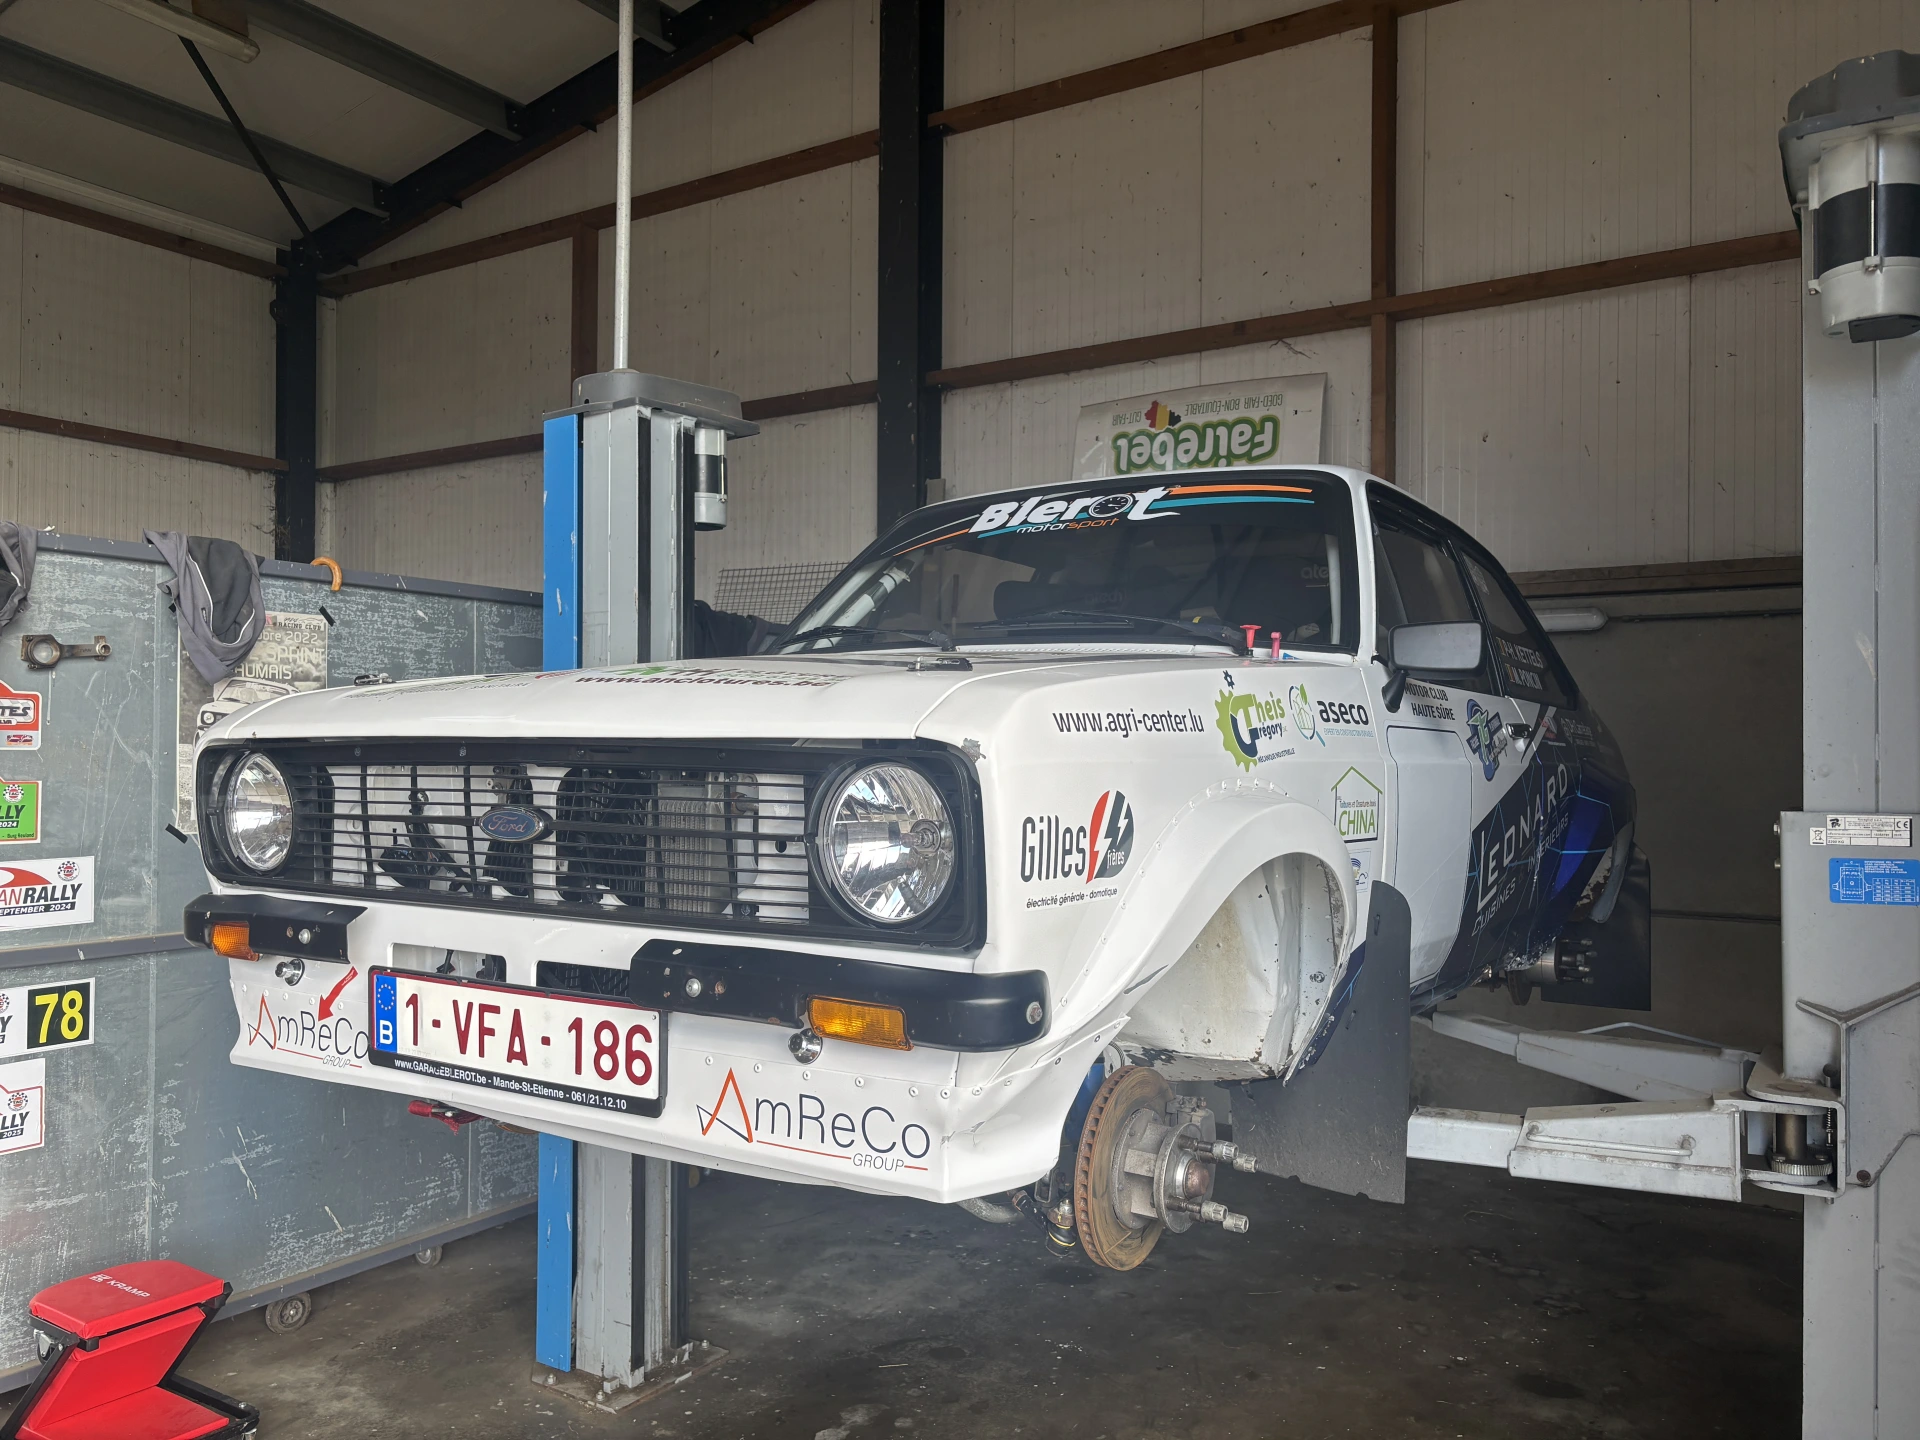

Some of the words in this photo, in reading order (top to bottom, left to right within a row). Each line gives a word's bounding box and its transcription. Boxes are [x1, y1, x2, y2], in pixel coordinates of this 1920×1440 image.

[1112, 410, 1142, 427] GUT-FAIR
[1115, 420, 1275, 472] Fairebel
[968, 486, 1180, 533] Blerot
[1016, 516, 1119, 534] motorsport
[285, 630, 318, 644] 2022
[266, 643, 325, 665] SPRINT
[1405, 682, 1430, 699] MOTOR
[1429, 687, 1449, 702] CLUB
[1052, 707, 1205, 739] www.agri-center.lu
[1316, 700, 1369, 726] aseco
[1411, 702, 1437, 719] HAUTE
[1436, 703, 1456, 721] SÛRE
[488, 814, 528, 833] Ford
[1338, 809, 1376, 836] CHINA
[1020, 814, 1087, 883] Gilles
[1476, 762, 1569, 914] LEONARD
[49, 903, 71, 911] 2024
[1026, 894, 1058, 909] électricité
[1058, 891, 1085, 907] générale
[1089, 887, 1118, 900] domotique
[1471, 877, 1517, 937] CUISINES
[35, 989, 84, 1044] 78
[247, 993, 369, 1060] AmReCo
[379, 1020, 394, 1045] B
[322, 1055, 351, 1069] GROUP
[394, 1058, 487, 1084] www.GARAGEBLEROT.be
[493, 1076, 564, 1099] Mande-St-Etienne
[571, 1091, 627, 1110] 061/21.12.10
[696, 1067, 931, 1159] AmReCo
[852, 1153, 905, 1173] GROUP
[107, 1280, 151, 1298] KRAMP
